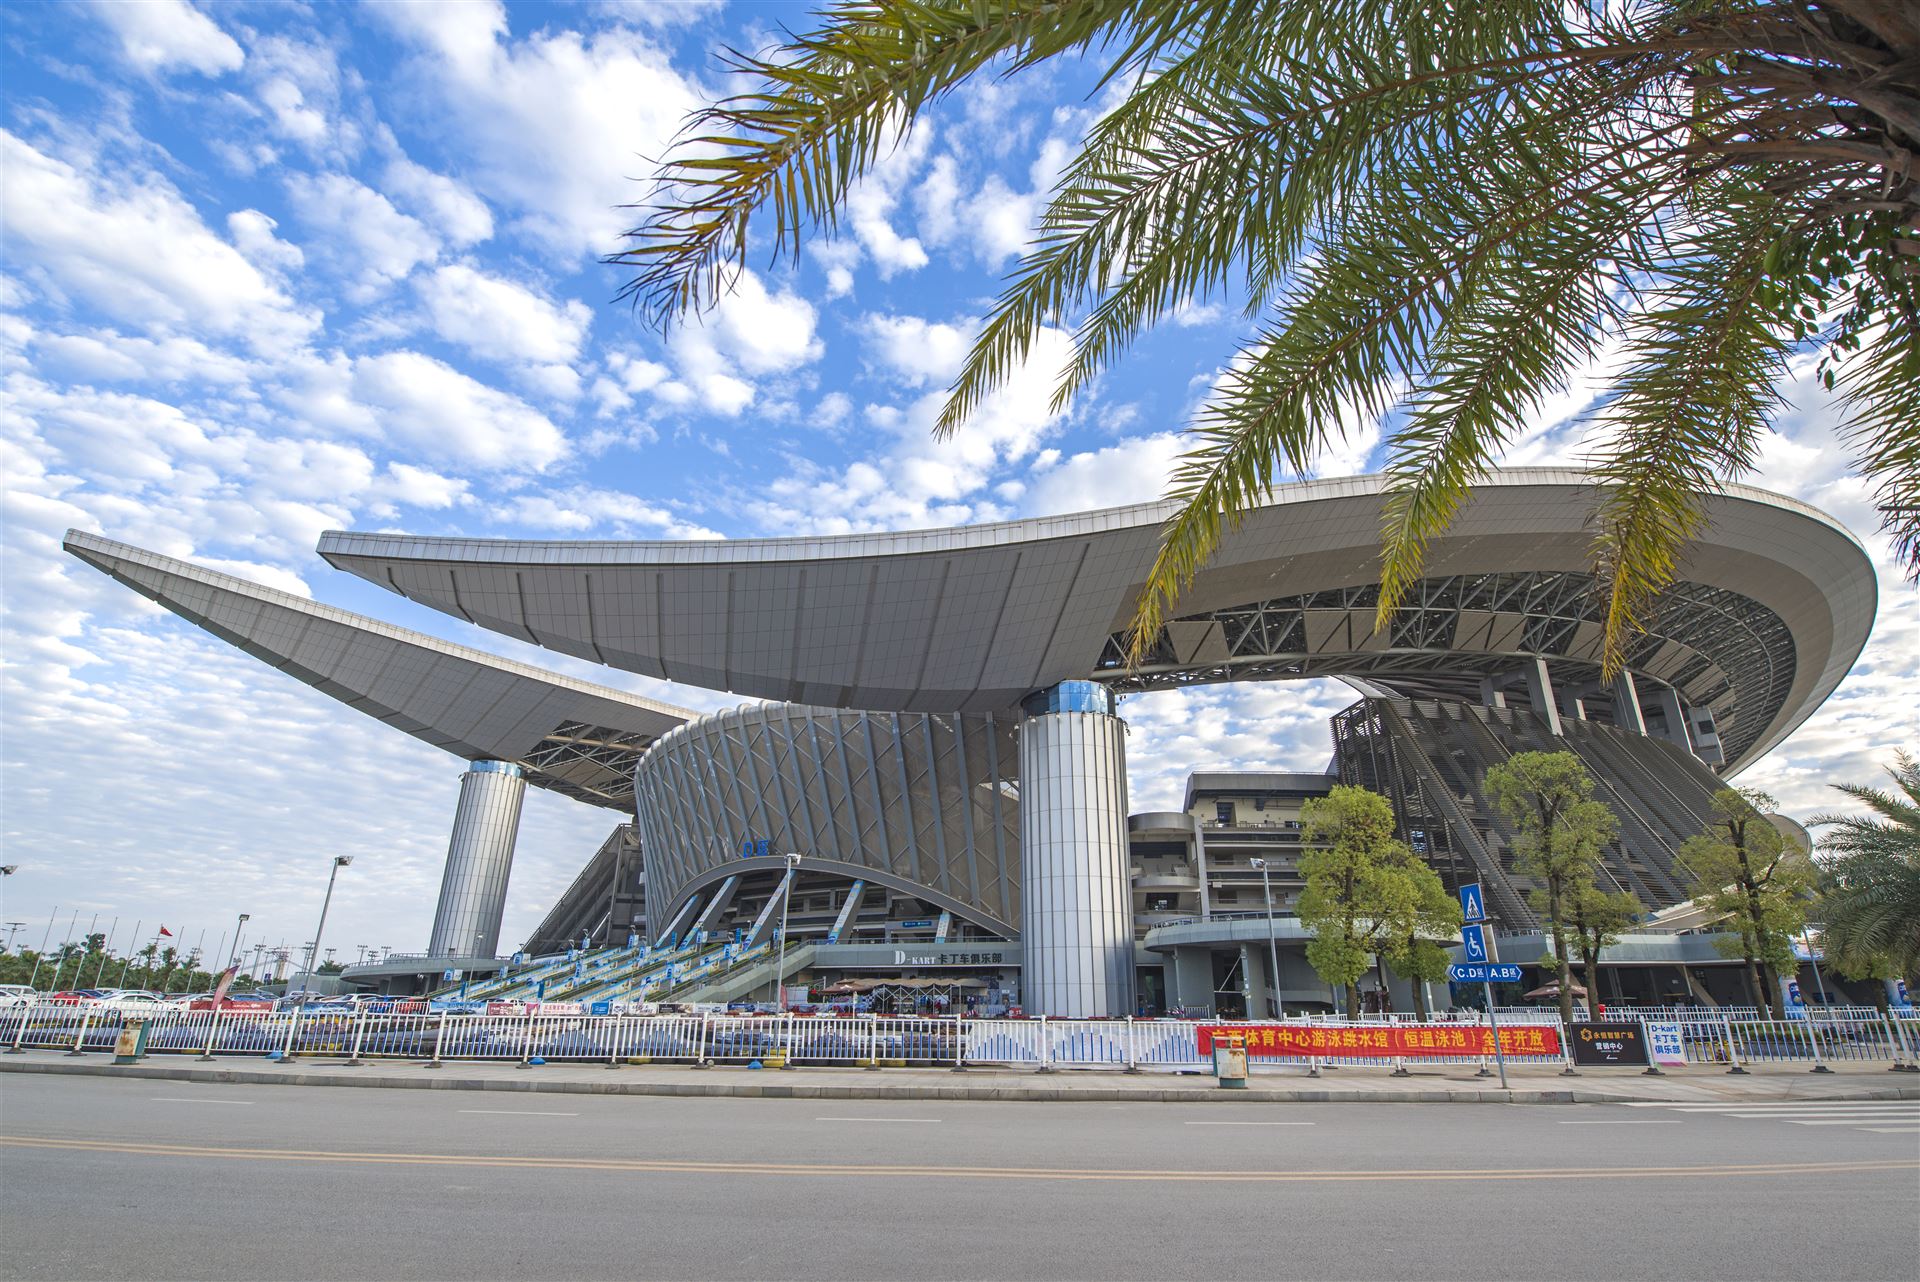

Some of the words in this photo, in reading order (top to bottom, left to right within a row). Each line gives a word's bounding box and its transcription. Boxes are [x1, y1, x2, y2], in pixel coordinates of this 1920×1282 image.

[894, 950, 936, 965] D-KART
[938, 953, 1002, 964] 卡丁车俱乐部
[1651, 1024, 1677, 1032] D-kart
[1653, 1034, 1679, 1044] 卡丁车
[1654, 1045, 1681, 1055] 俱乐部
